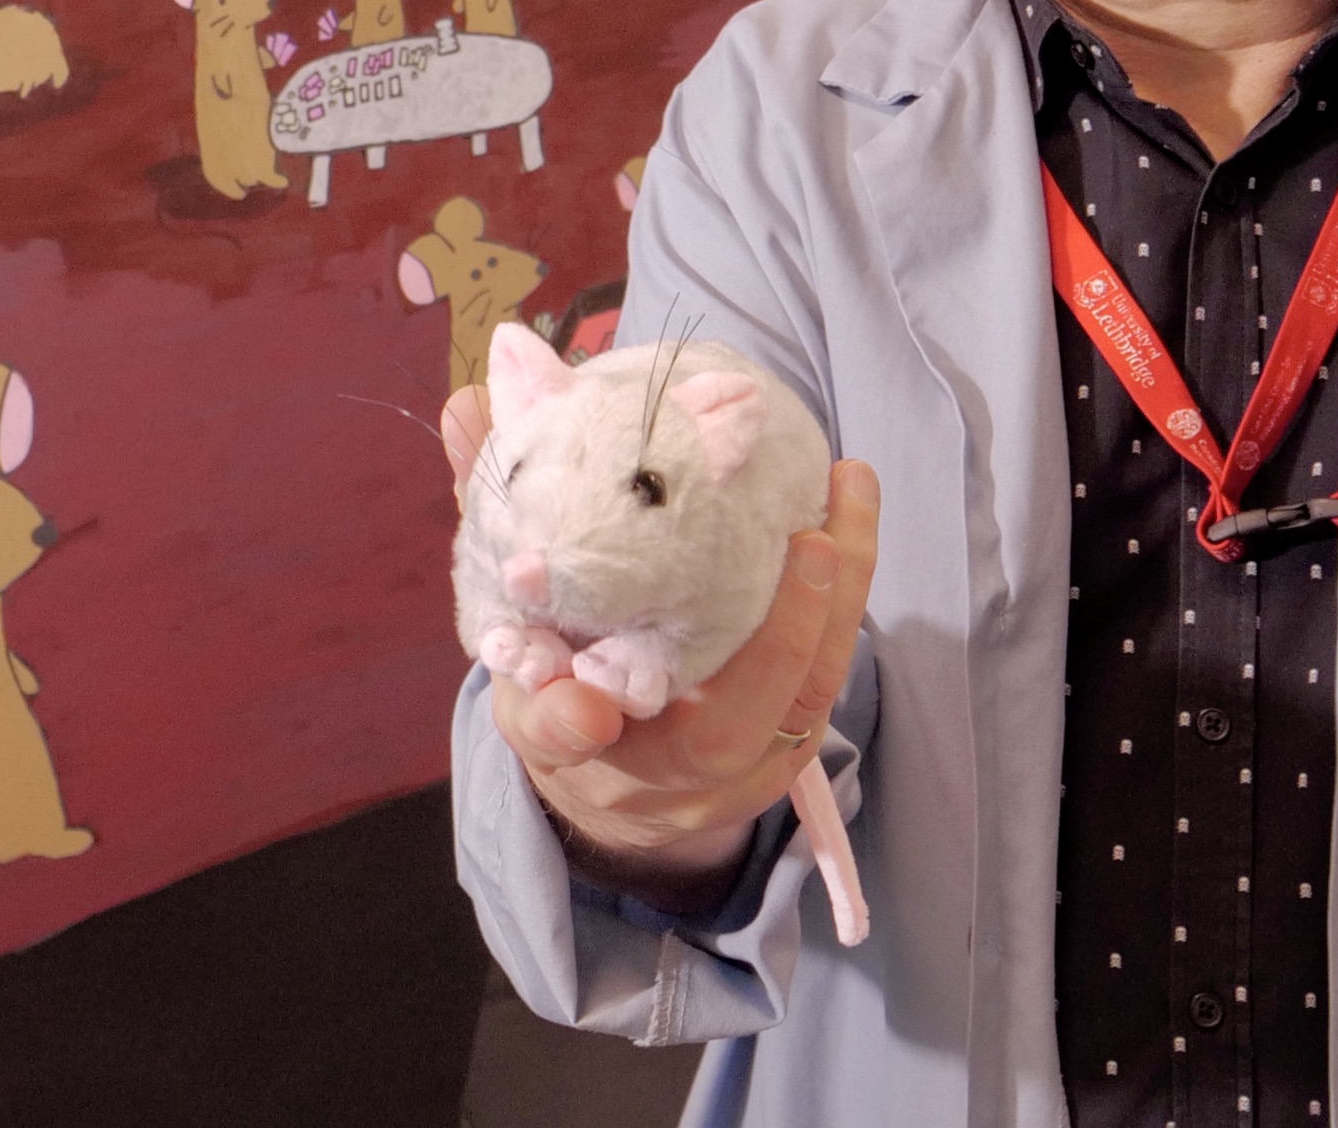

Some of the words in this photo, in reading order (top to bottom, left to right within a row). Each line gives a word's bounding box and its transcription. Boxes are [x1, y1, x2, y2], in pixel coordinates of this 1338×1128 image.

[1091, 301, 1156, 389] Lethbridge
[1112, 293, 1153, 349] University
[1148, 345, 1162, 360] of
